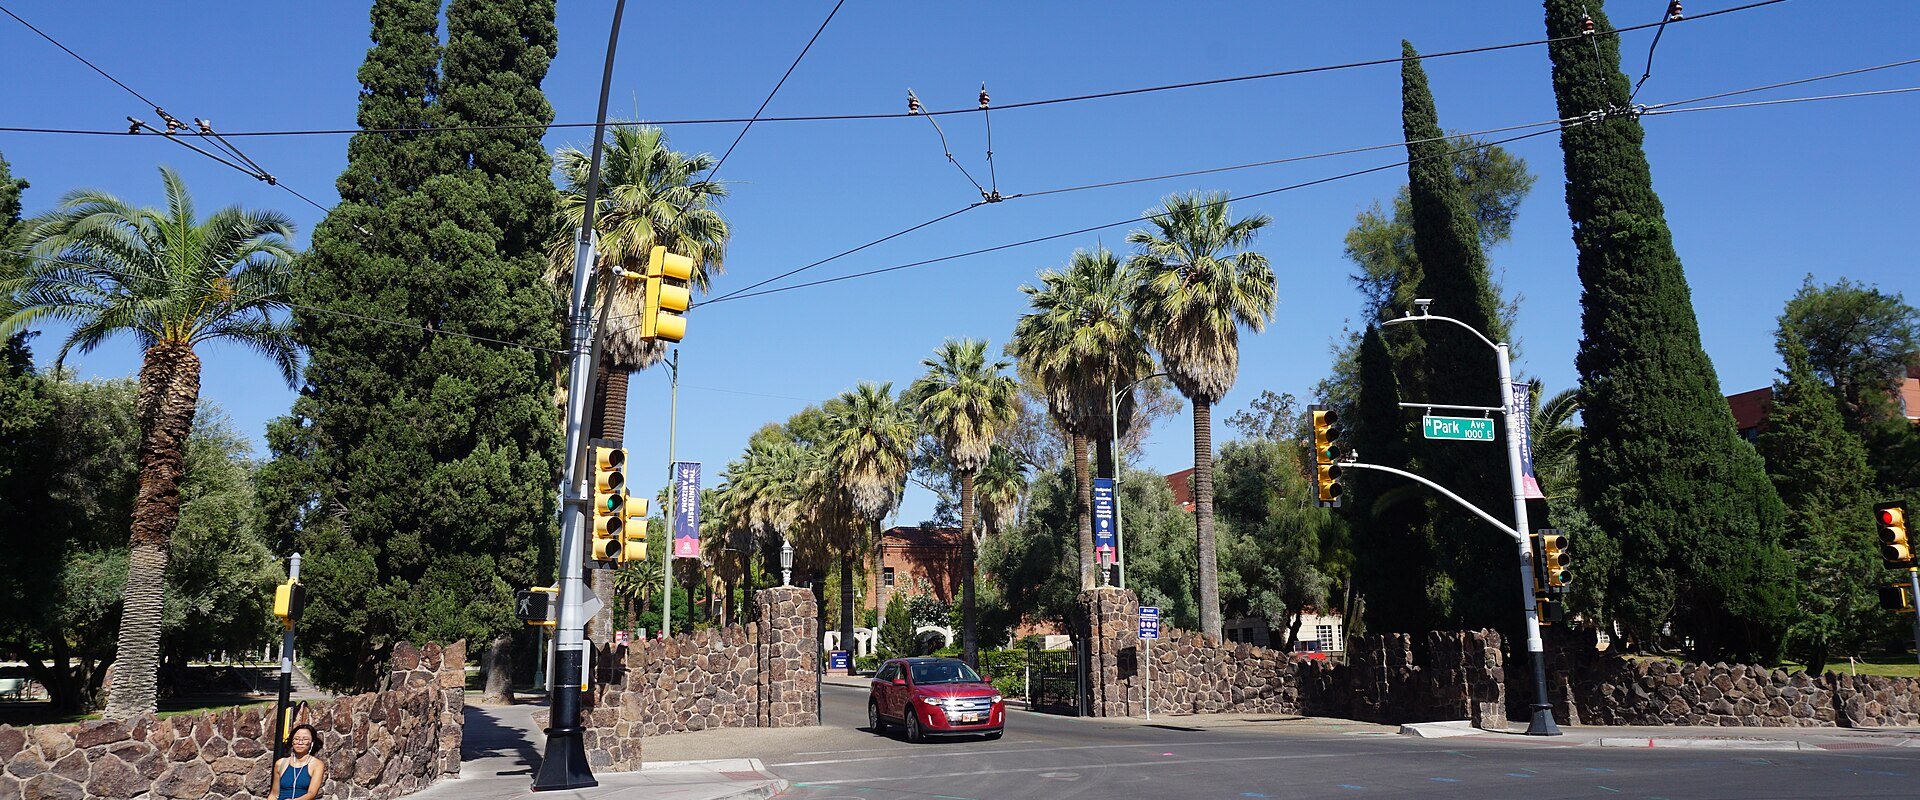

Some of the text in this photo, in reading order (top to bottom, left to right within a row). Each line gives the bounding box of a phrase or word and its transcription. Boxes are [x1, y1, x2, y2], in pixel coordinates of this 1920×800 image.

[1425, 418, 1486, 436] N Park Ave
[1464, 429, 1493, 439] 1000 E
[1520, 411, 1529, 464] UNIVERSITY
[681, 468, 689, 514] OF ARIZONA
[687, 469, 696, 528] THE UNIVERSITY
